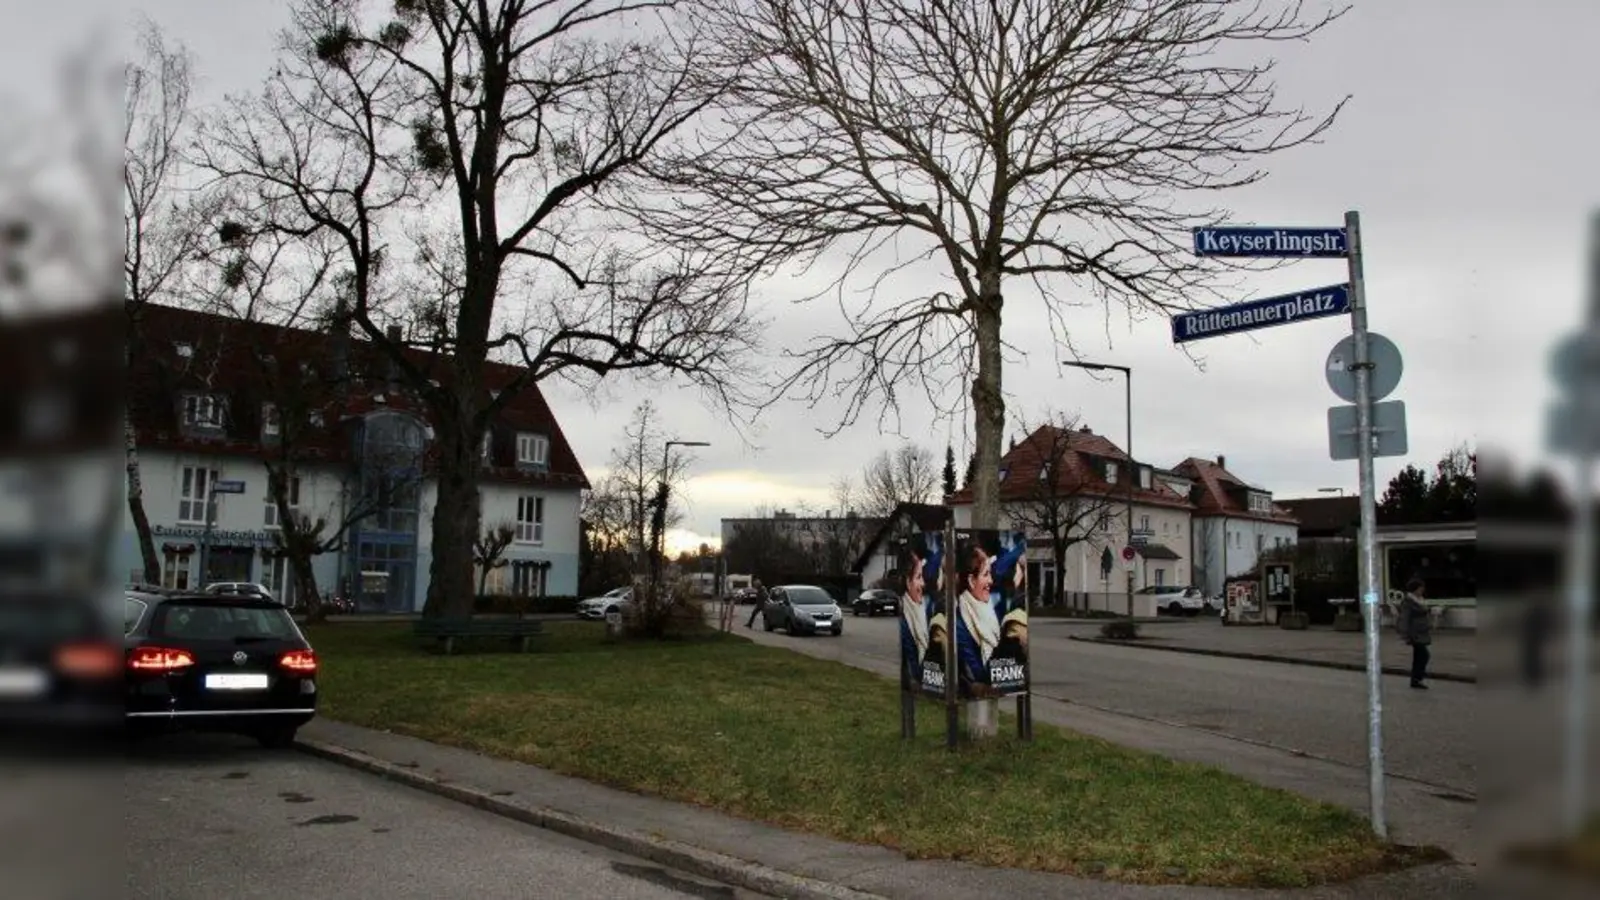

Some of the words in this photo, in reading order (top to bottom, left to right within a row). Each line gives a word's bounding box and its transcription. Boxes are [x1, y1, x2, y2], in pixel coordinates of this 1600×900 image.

[1203, 230, 1343, 254] Keyserlingstr.
[1185, 293, 1335, 335] Rüttenauerplatz
[990, 665, 1025, 682] FRANK
